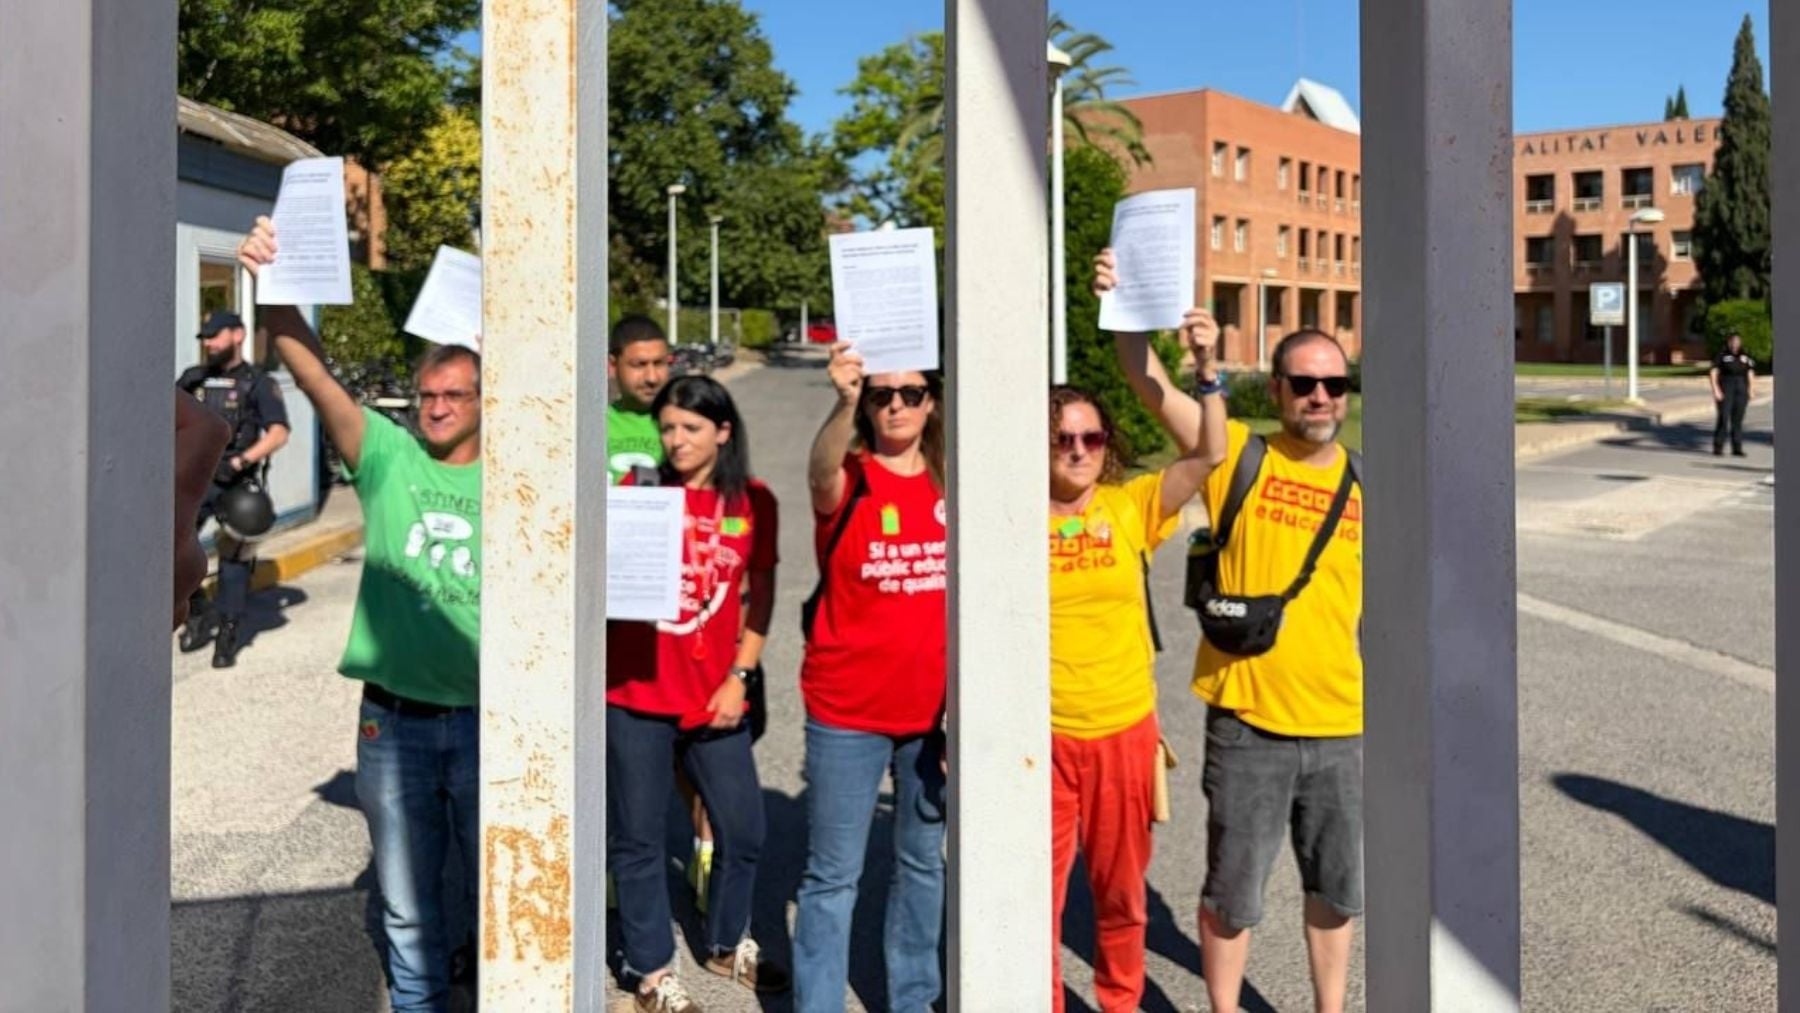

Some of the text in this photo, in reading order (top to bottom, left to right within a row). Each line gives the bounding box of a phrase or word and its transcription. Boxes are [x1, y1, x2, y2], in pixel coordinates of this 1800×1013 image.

[1521, 133, 1609, 155] ALITAT
[1597, 288, 1617, 308] P
[1255, 505, 1359, 542] edució
[888, 544, 898, 559] a
[900, 543, 921, 558] un
[879, 577, 901, 593] de
